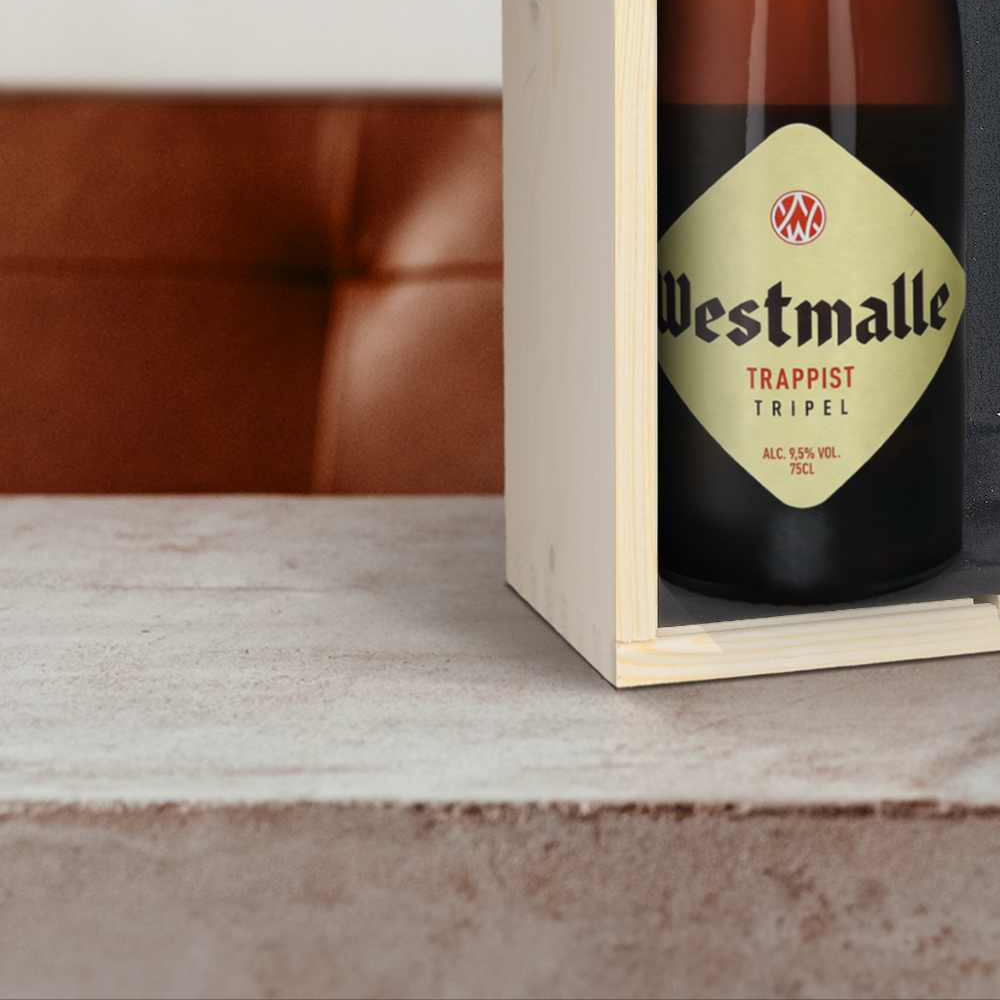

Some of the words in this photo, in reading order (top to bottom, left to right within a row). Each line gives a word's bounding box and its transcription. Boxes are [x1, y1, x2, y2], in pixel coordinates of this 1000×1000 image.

[658, 268, 950, 348] Westmalle
[746, 366, 855, 389] TRAPPIST
[754, 398, 849, 417] TRIPEL
[762, 447, 786, 460] ALC.
[788, 447, 815, 461] 9,5%
[817, 446, 841, 459] VOL.
[789, 462, 815, 475] 75CL
